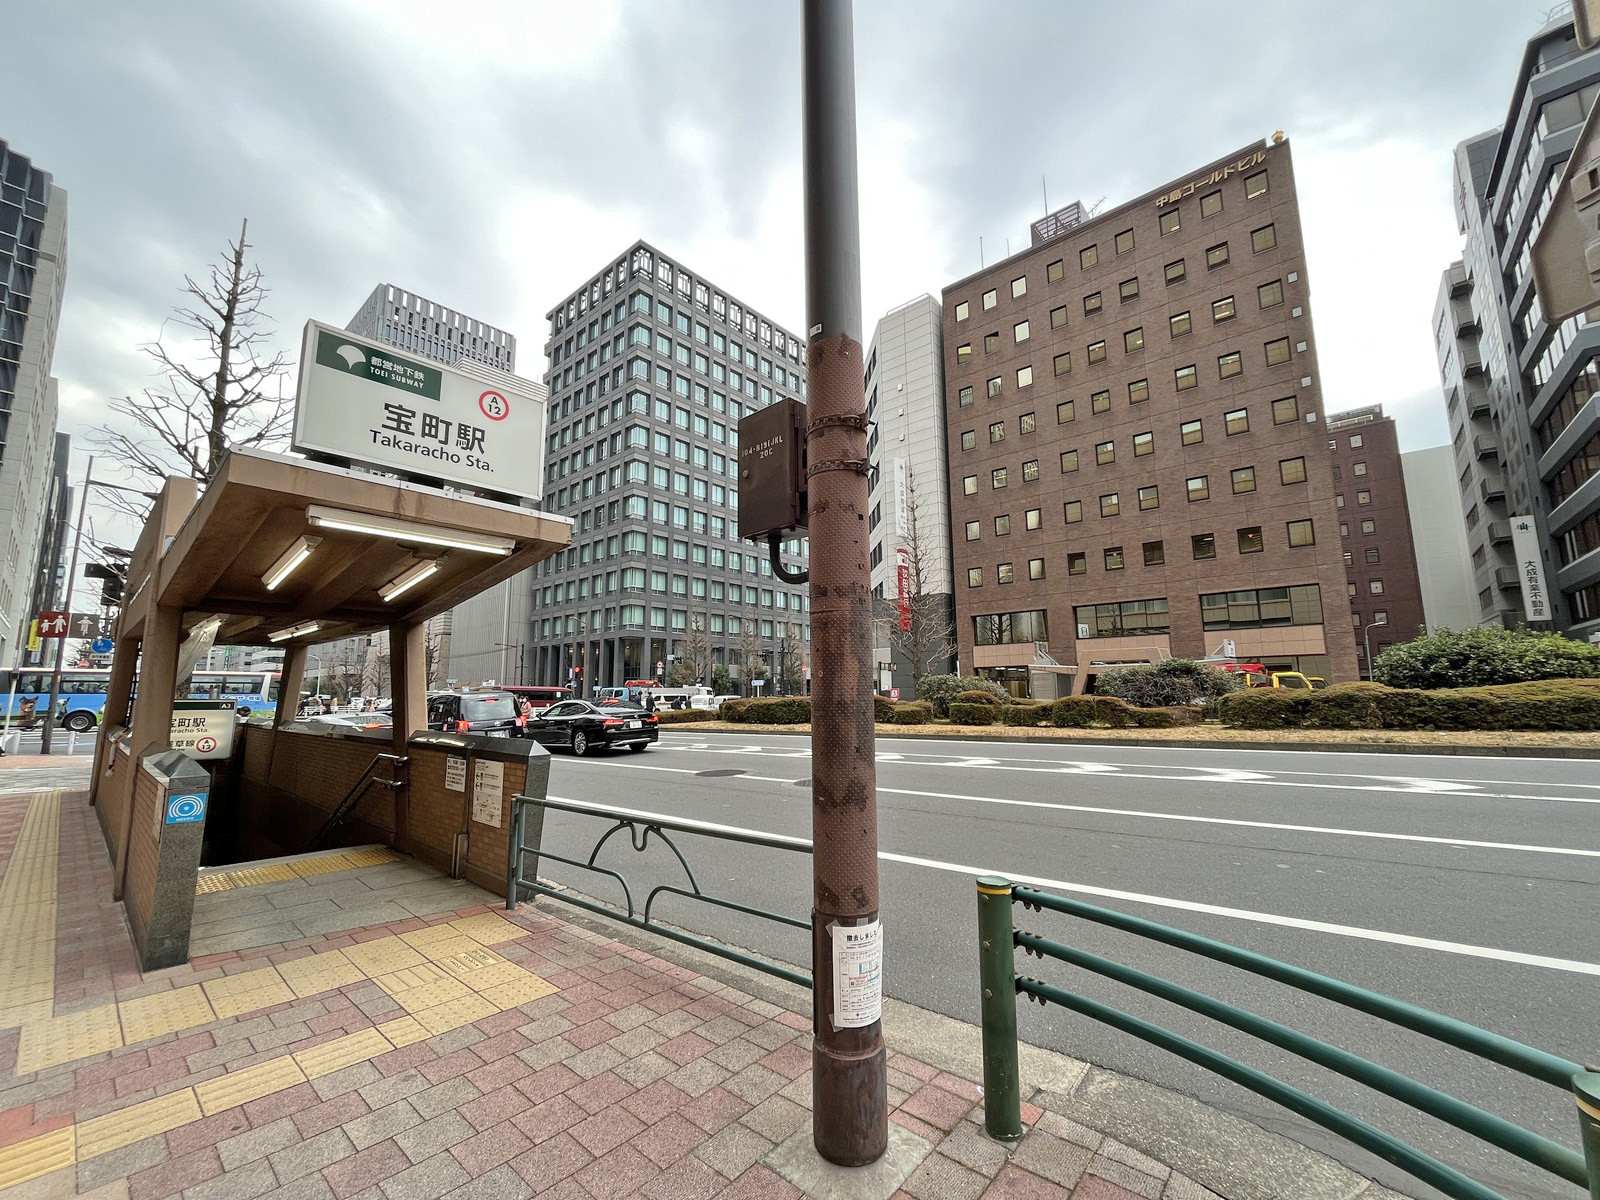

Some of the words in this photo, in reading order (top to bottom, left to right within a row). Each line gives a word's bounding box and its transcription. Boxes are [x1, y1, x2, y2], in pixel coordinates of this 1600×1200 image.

[370, 355, 425, 382] 都営地下鉄
[370, 367, 388, 379] TOEI
[391, 373, 424, 389] SUBWAY
[488, 404, 501, 416] 12
[490, 396, 499, 405] A
[381, 402, 486, 455] 宝町駅
[370, 429, 461, 464] Takaracho
[466, 454, 494, 473] Sta.
